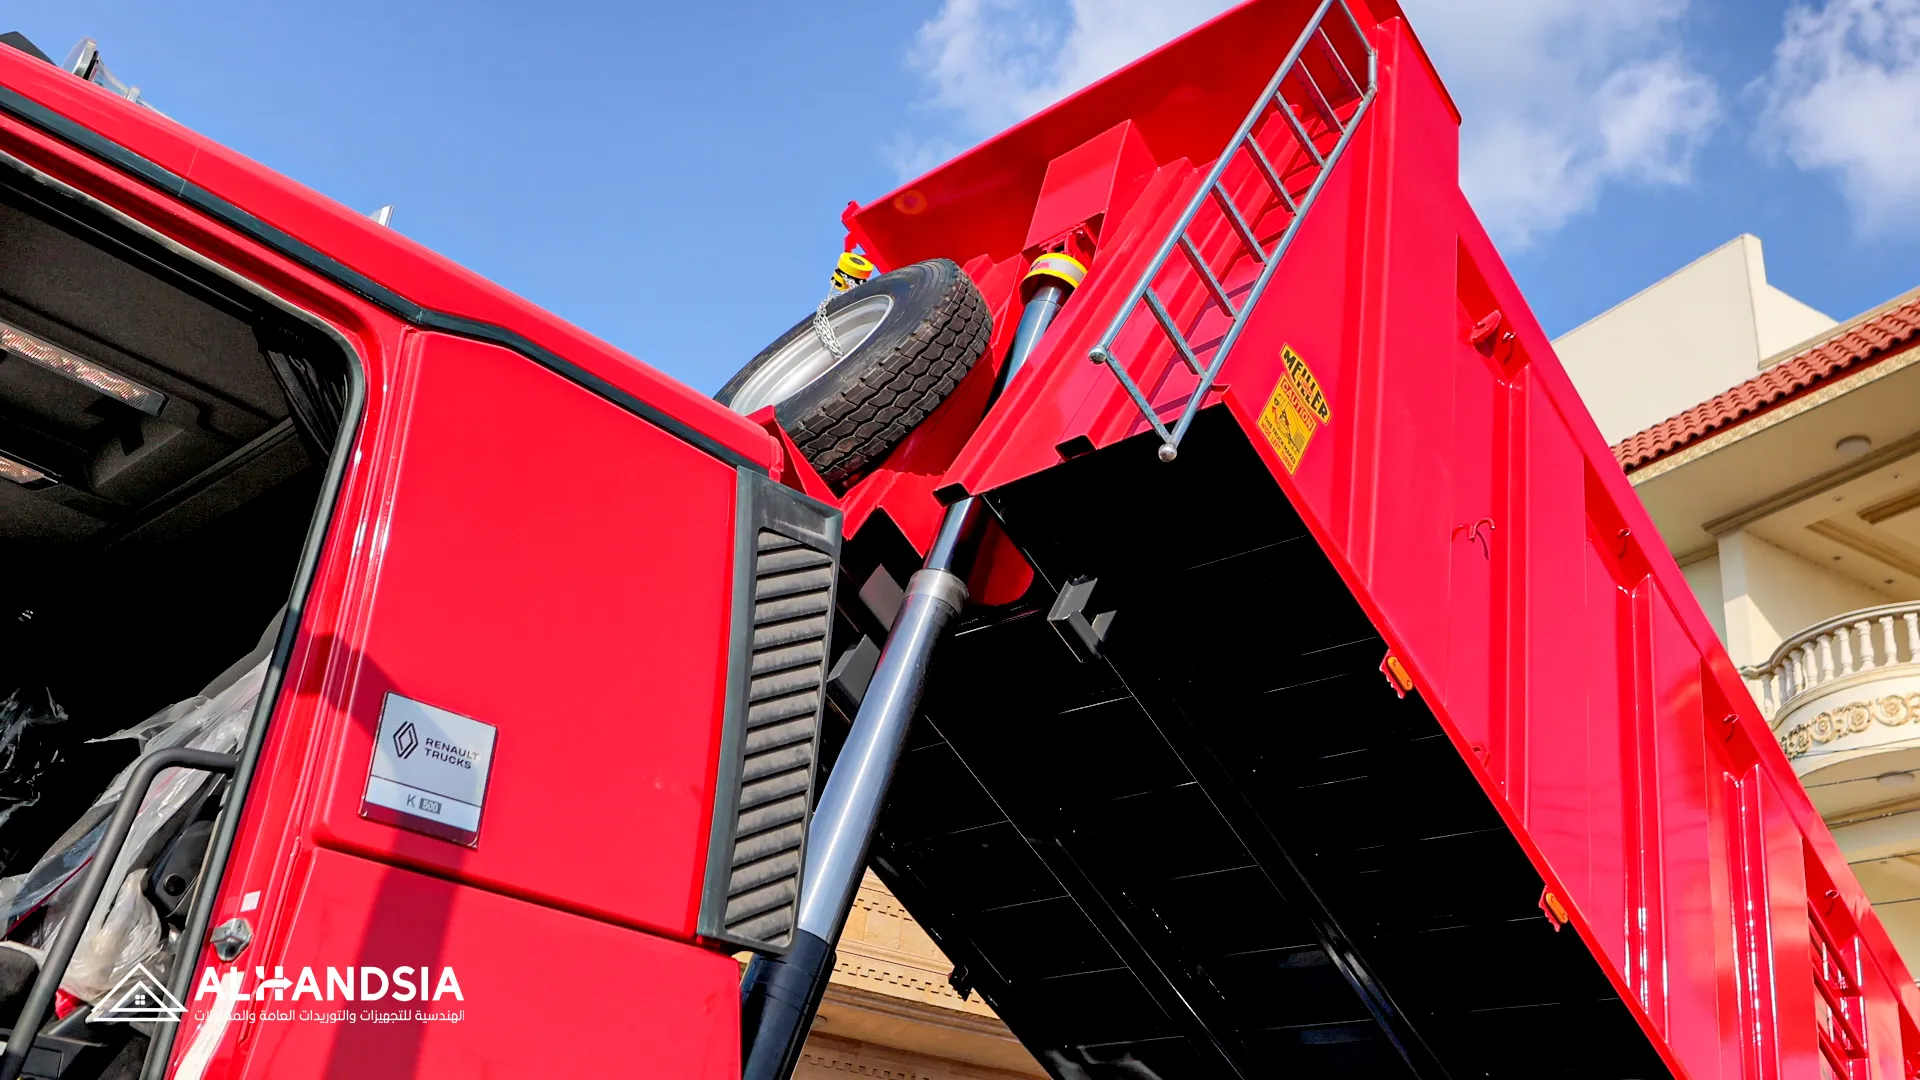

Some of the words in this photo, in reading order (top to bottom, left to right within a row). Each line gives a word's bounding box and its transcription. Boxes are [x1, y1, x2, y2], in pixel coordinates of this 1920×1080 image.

[1283, 349, 1328, 419] MEILLER
[1281, 380, 1315, 430] CAUTION
[1260, 422, 1272, 438] WIDE
[1270, 436, 1282, 451] LEFT
[1264, 415, 1273, 429] THIS
[1272, 427, 1284, 447] TRUCK
[424, 747, 472, 770] TRUCKS
[425, 737, 479, 761] RENAULT
[406, 794, 416, 808] K
[423, 800, 438, 813] 500
